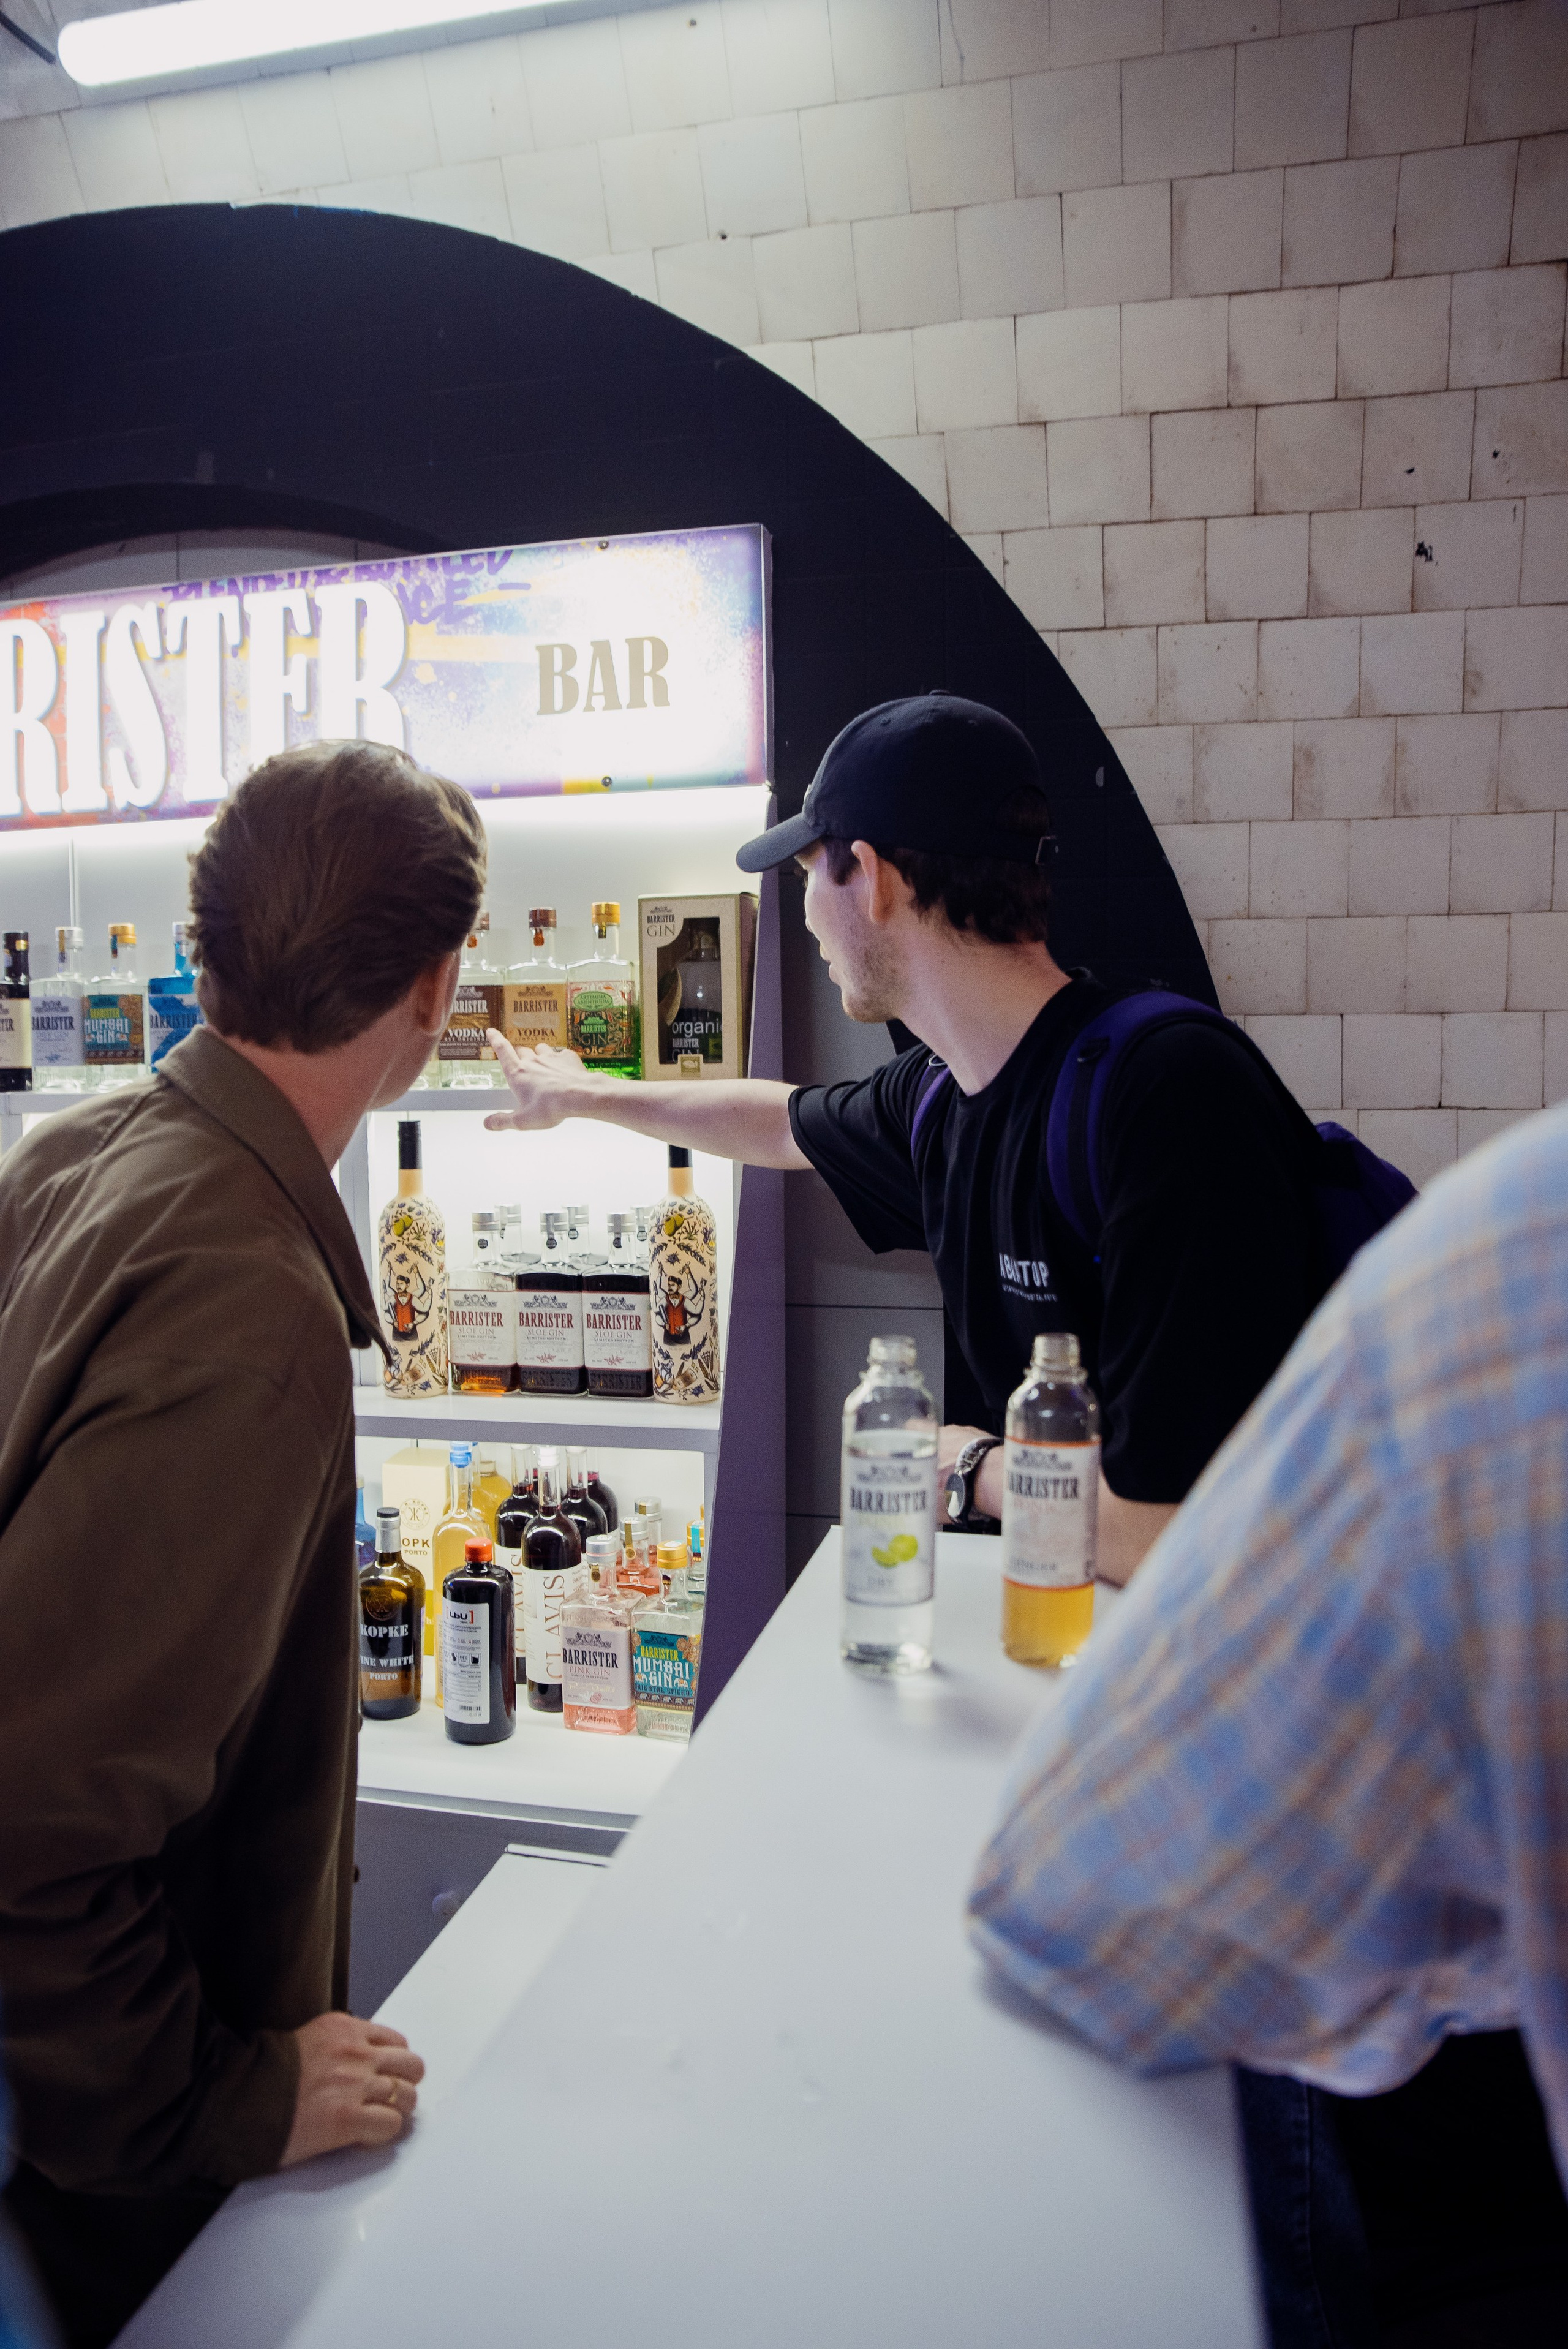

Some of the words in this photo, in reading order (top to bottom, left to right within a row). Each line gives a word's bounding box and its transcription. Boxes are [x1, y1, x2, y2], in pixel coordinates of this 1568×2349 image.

[535, 636, 670, 715] BAR
[647, 914, 675, 924] BARRISTER
[647, 924, 675, 937] GIN
[452, 1000, 488, 1013] RRISTER
[513, 1000, 558, 1013] BARRISTER
[84, 1018, 129, 1035] MUMBAI
[448, 1028, 486, 1037] VODKA
[518, 1028, 557, 1037] VODKA
[97, 1029, 115, 1044] GIN
[581, 1033, 608, 1046] GIN
[673, 1038, 699, 1048] BARRISTER
[450, 1310, 504, 1327] BARRISTER
[519, 1311, 574, 1329] BARRISTER
[586, 1313, 643, 1331] BARRISTER
[850, 1487, 927, 1514] BARRISTER
[402, 1537, 431, 1548] OPK
[360, 1624, 409, 1638] KOPKE
[562, 1648, 619, 1669] BARRISTER
[640, 1645, 679, 1661] BARRISTER
[360, 1655, 376, 1667] INE
[379, 1654, 415, 1668] WHITE
[633, 1655, 690, 1680] MUMBAI
[369, 1672, 398, 1681] PORTO
[569, 1665, 591, 1676] PINK
[594, 1667, 611, 1677] GIN
[649, 1670, 673, 1689] GIN
